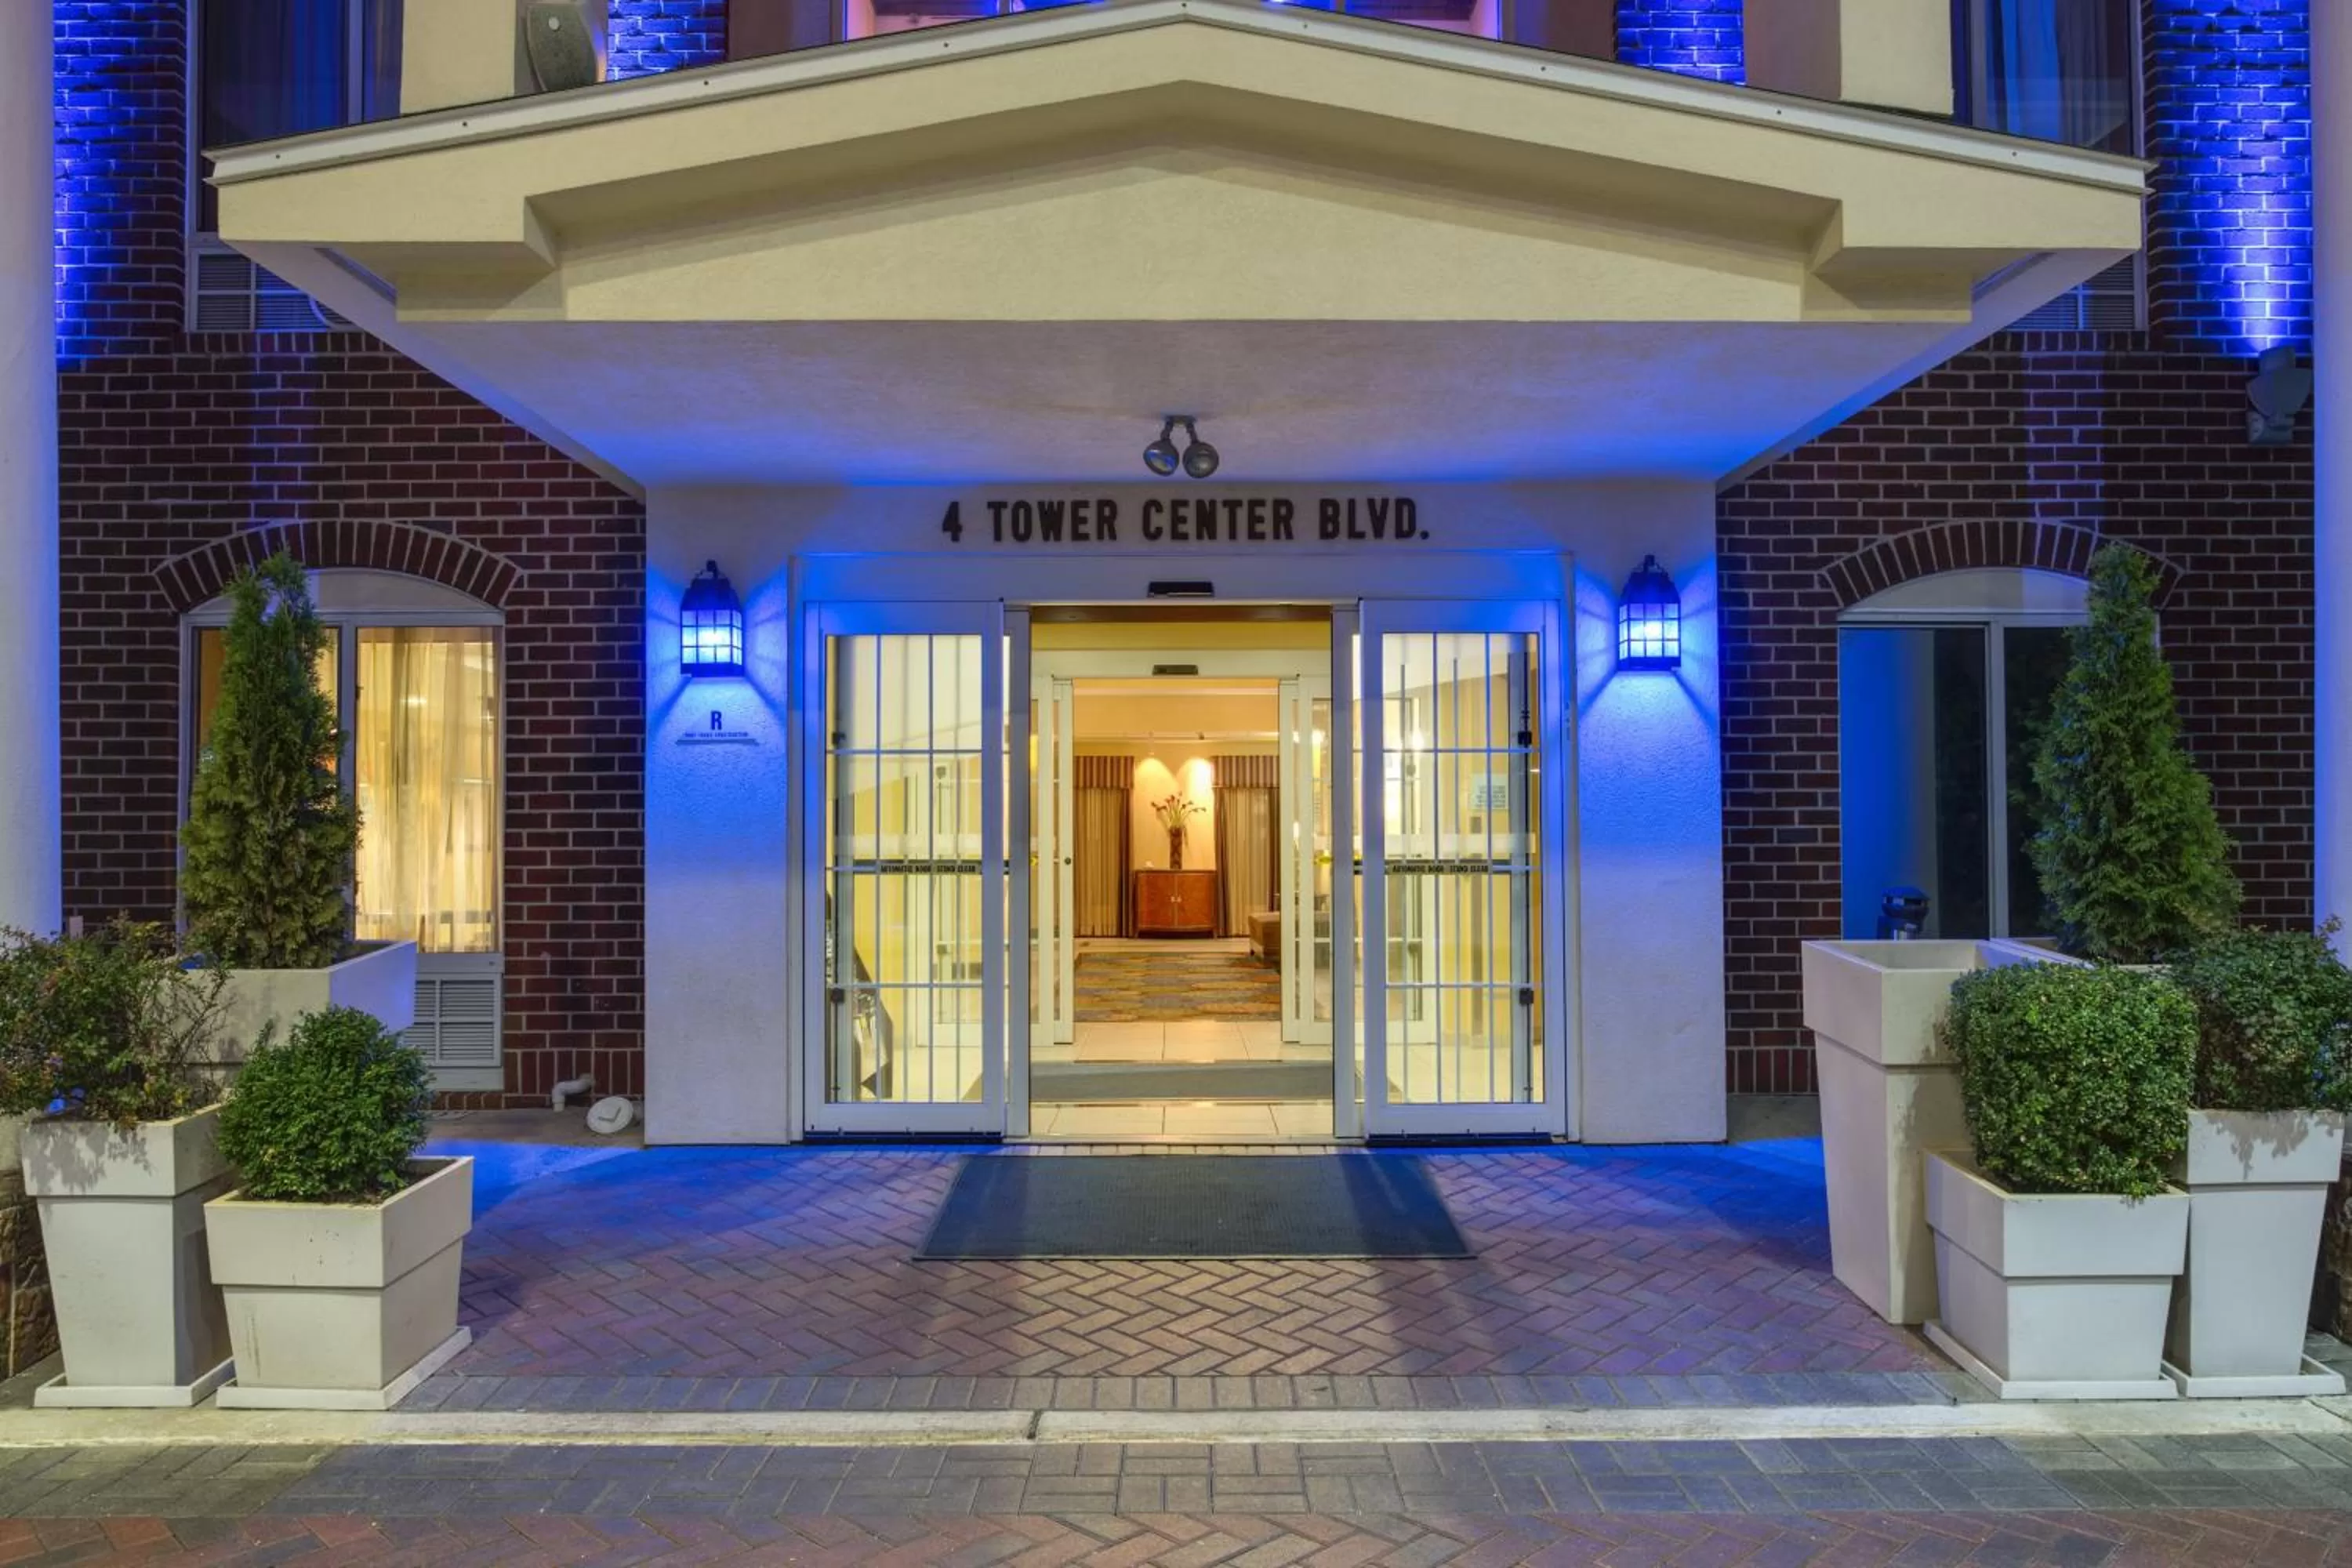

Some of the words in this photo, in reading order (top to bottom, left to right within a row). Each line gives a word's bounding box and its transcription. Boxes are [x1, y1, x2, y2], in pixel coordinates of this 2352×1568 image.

[941, 499, 964, 544] 4
[985, 498, 1120, 544] TOWER
[1141, 496, 1297, 543] CENTER
[1317, 495, 1431, 543] BLVD.
[711, 710, 722, 730] R
